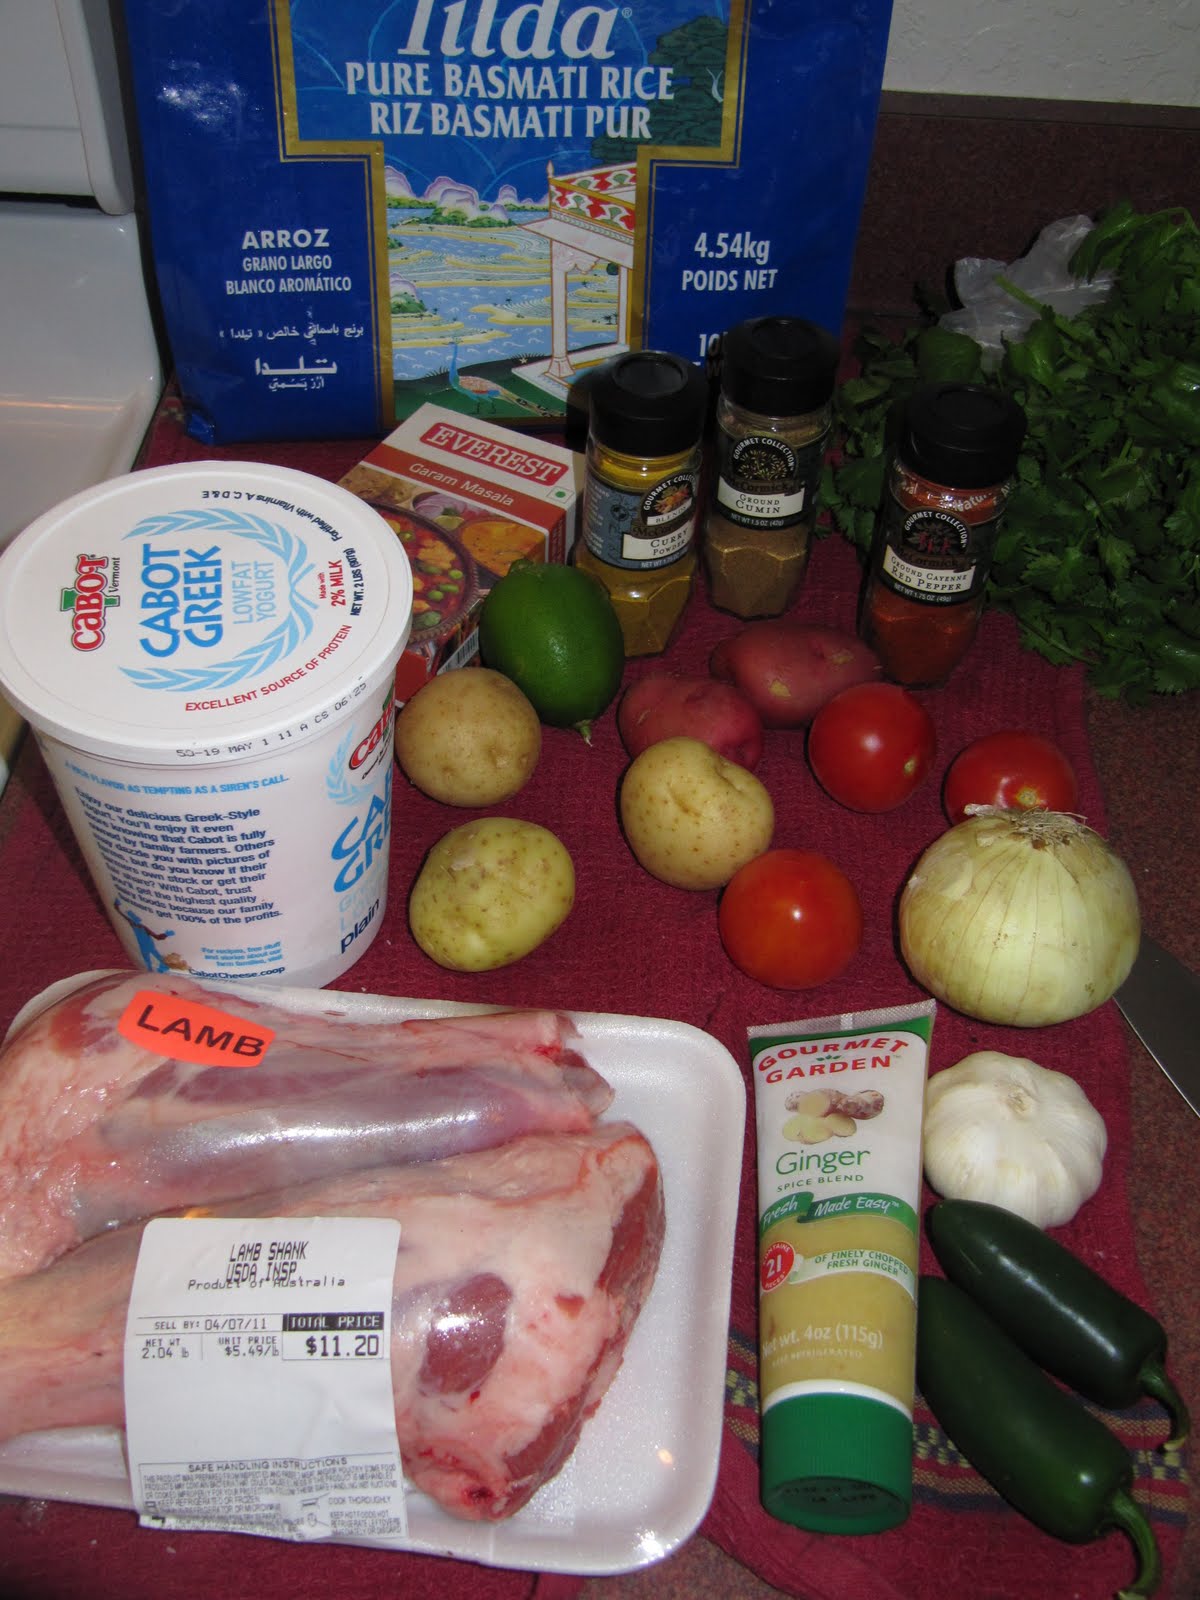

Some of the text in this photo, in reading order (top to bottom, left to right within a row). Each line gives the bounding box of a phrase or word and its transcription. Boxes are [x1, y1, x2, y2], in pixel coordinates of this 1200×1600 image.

[345, 61, 675, 100] PURE BASMATI RICE
[370, 102, 652, 139] RIZ BASMATI PUR
[242, 228, 330, 250] ARROZ
[694, 231, 770, 265] 4.54kg
[242, 254, 332, 272] GRANO LARGO
[226, 273, 352, 295] BLANCO AROMÁTICO
[681, 269, 778, 291] POIDS NET
[426, 425, 562, 482] EVEREST
[733, 437, 795, 468] GOURMET COLLECTION
[202, 490, 210, 499] E
[222, 490, 230, 499] D
[409, 463, 514, 506] Garam Masala
[256, 494, 295, 513] Vitamins
[643, 480, 671, 511] GOURMET
[739, 494, 780, 505] GROUND
[296, 507, 314, 520] with
[735, 500, 781, 513] CUMIN
[312, 516, 342, 541] Fortified
[760, 519, 768, 527] OZ
[904, 511, 969, 545] GOURMET COLLECTION
[650, 527, 688, 548] CURRY
[653, 539, 686, 555] POWDER
[108, 557, 121, 594] Vermont
[352, 568, 363, 582] LBS
[891, 556, 967, 582] GROUND CAYENNE
[891, 566, 962, 591] RED PEPPER
[231, 560, 254, 625] LOWFAT
[254, 560, 277, 623] YOGURT
[328, 559, 346, 607] 2% MILK
[139, 543, 180, 658] CABOT
[183, 545, 223, 648] GREEK
[350, 602, 362, 616] NET
[185, 624, 352, 711] EXCELLENT SOURCE OF PROTEIN
[228, 741, 252, 753] MAY
[278, 730, 292, 740] 11
[314, 711, 329, 723] CS
[141, 785, 192, 795] TEMPTING
[195, 785, 208, 794] AS
[127, 808, 181, 822] delicious
[185, 808, 260, 822] Greek-Style
[154, 824, 234, 834] enjoy it even
[161, 834, 185, 844] that
[187, 835, 224, 844] Cabot
[226, 834, 238, 842] is
[240, 830, 266, 841] fully
[234, 839, 275, 852] Others
[176, 856, 203, 865] with
[205, 854, 256, 867] pictures
[258, 849, 270, 859] of
[192, 866, 225, 875] know
[240, 861, 267, 873] their
[167, 875, 199, 884] stock
[217, 877, 237, 886] get
[239, 872, 267, 883] their
[174, 894, 257, 906] highest quality
[225, 885, 252, 895] trust
[168, 902, 274, 915] because our family
[175, 914, 207, 924] 100%
[223, 916, 242, 924] the
[341, 899, 380, 954] plain
[137, 1004, 265, 1057] LAMB
[758, 1037, 909, 1072] GOURMET
[765, 1055, 892, 1084] GARDEN
[775, 1150, 871, 1175] Ginger
[776, 1174, 864, 1192] SPICE BLEND
[763, 1195, 798, 1227] Fresh
[814, 1196, 851, 1216] Made
[229, 1241, 309, 1262] LAMB SHANK
[226, 1261, 298, 1283] USDA INSP
[766, 1254, 782, 1279] 21
[814, 1250, 909, 1275] OF FINELY CHOPPED
[826, 1259, 899, 1276] FRESH GINGER
[187, 1275, 345, 1290] Product of Australia
[154, 1314, 380, 1331] SELL BY: 04/07/11 TOTAL PRICE
[804, 1324, 832, 1342] 4oz
[142, 1334, 380, 1359] 2.04 $5.49/lb $11.20
[145, 1338, 163, 1347] NET
[218, 1336, 241, 1345] UNIT
[248, 1336, 277, 1345] PRICE
[188, 1456, 348, 1472] SAFE HANDLING INSTRUCTIONS
